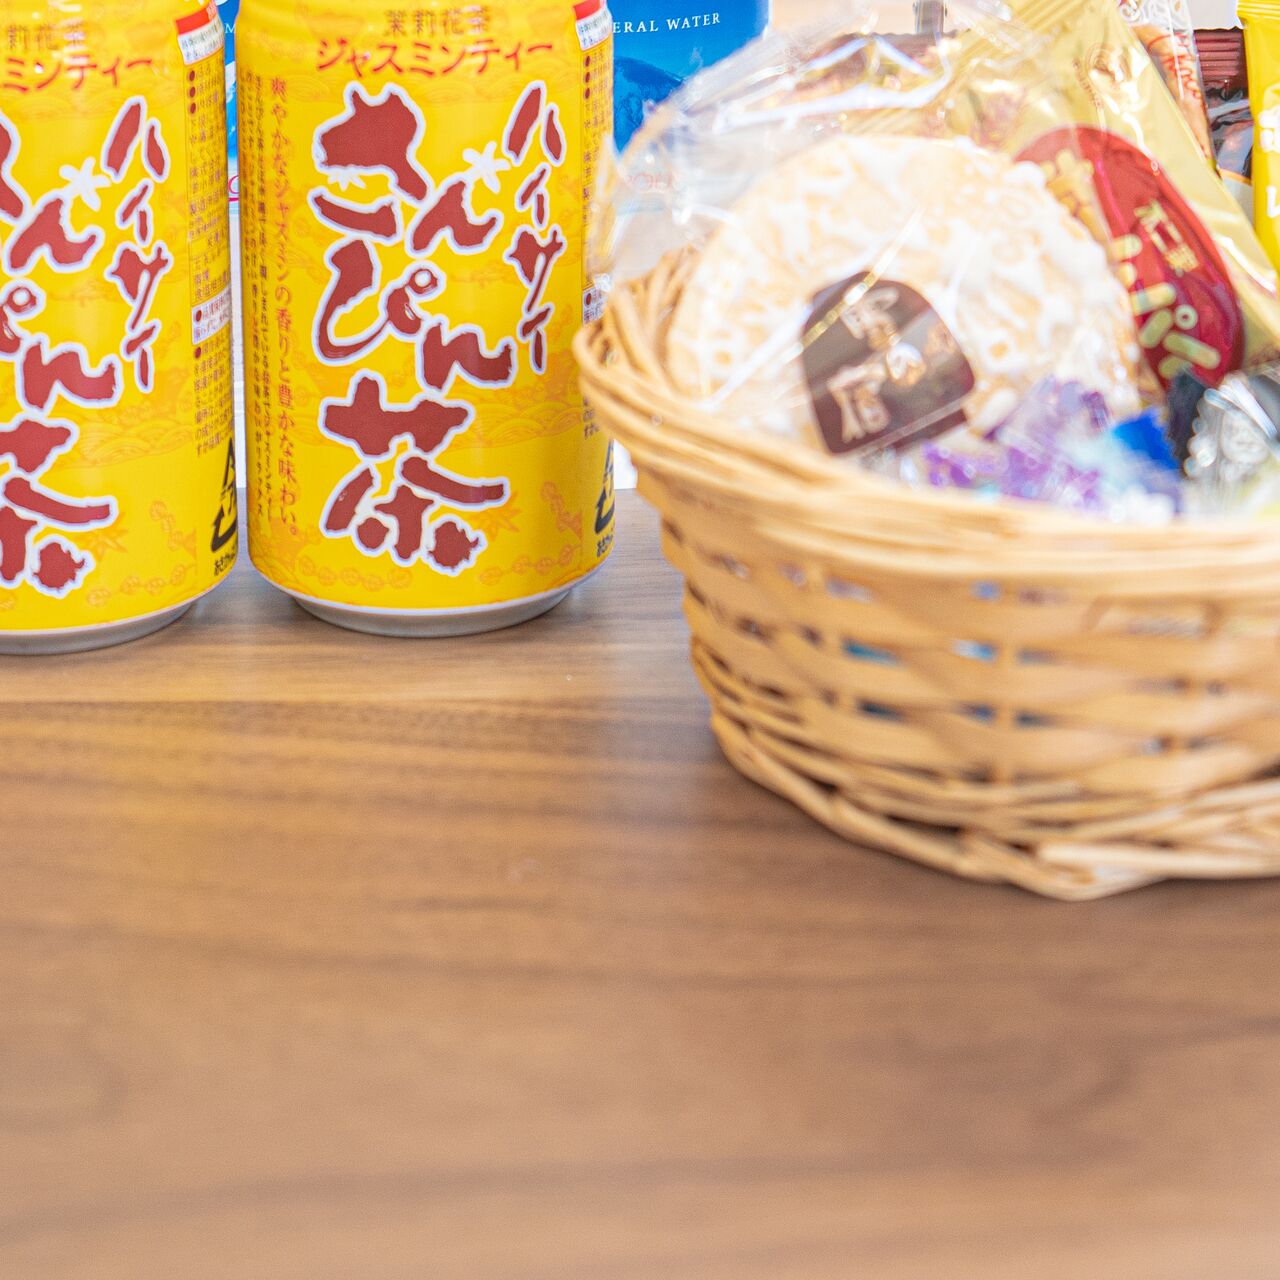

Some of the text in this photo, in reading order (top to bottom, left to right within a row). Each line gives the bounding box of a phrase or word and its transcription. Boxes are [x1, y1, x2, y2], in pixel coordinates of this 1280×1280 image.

[612, 21, 658, 34] ERAL
[666, 12, 721, 29] WATER
[317, 38, 554, 79] ジャスミンティー
